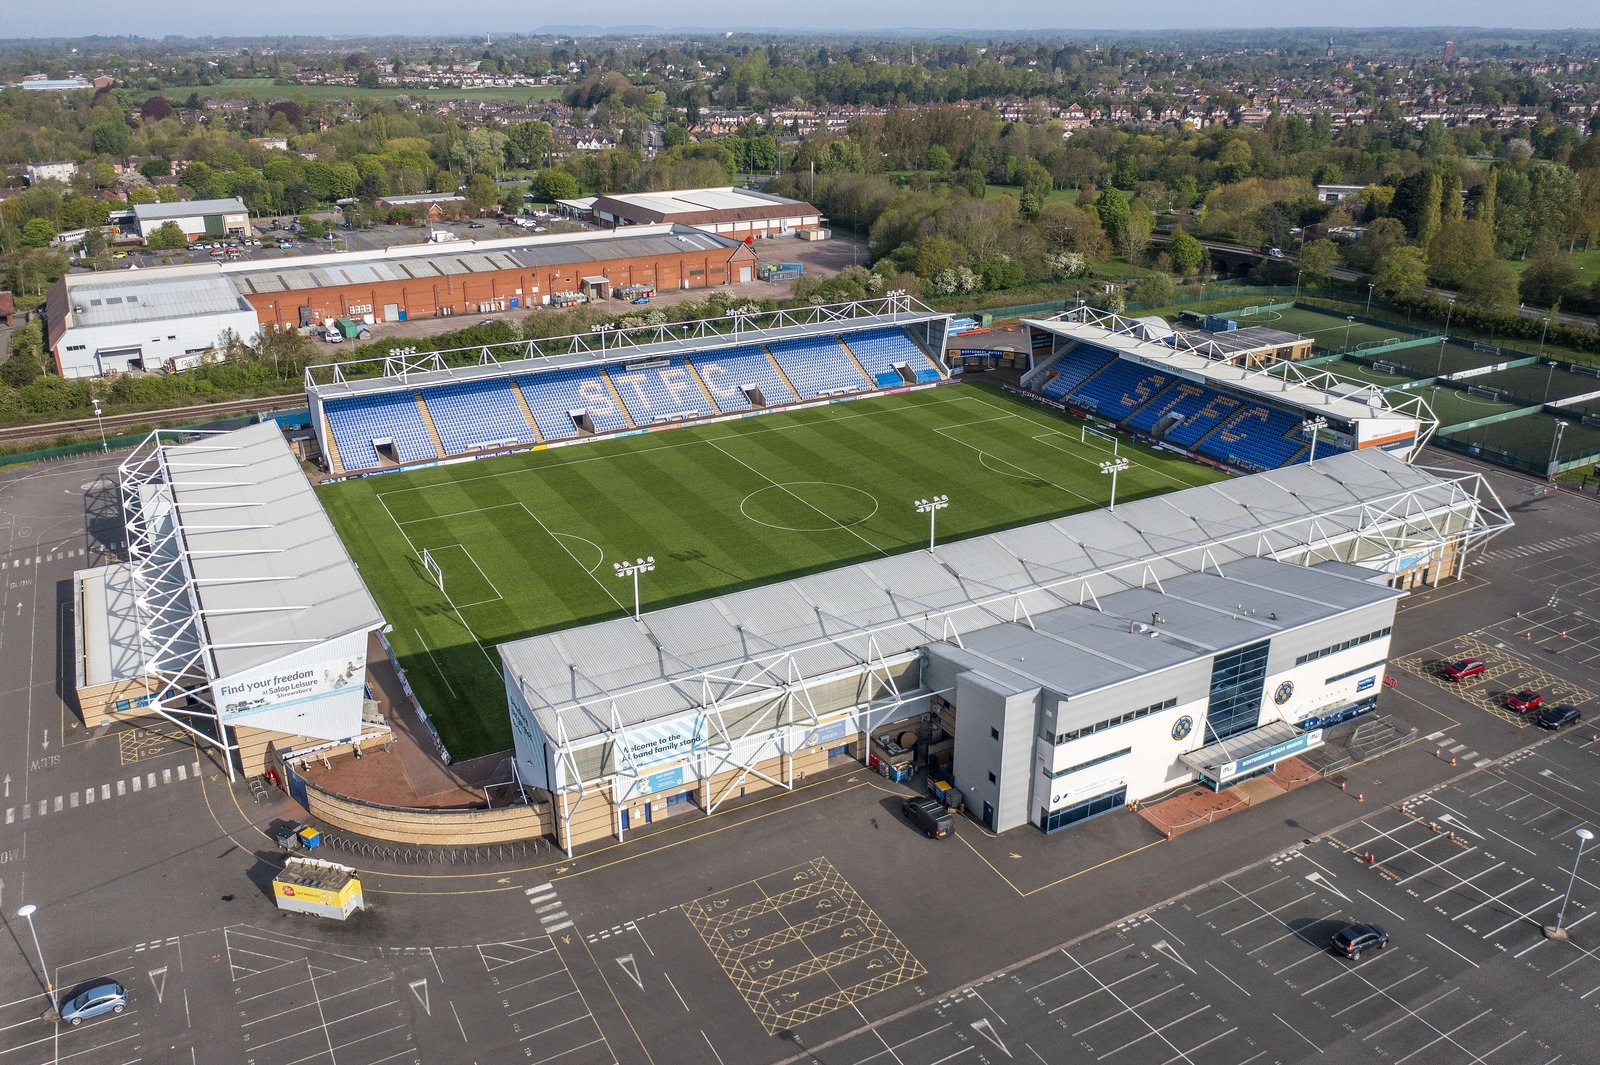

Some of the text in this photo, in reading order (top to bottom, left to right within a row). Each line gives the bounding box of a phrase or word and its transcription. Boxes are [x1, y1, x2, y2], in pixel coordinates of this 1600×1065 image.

[579, 364, 736, 415] STFC
[1120, 374, 1270, 442] STFC
[10, 579, 32, 589] SLOW
[220, 669, 315, 697] Find your freedom
[269, 685, 290, 696] Salop
[291, 679, 318, 691] Leisure
[276, 687, 313, 699] Shrewsbury
[654, 742, 678, 754] family
[680, 734, 703, 747] stand.
[659, 737, 667, 745] to
[668, 733, 681, 743] the
[30, 754, 61, 772] SLOW
